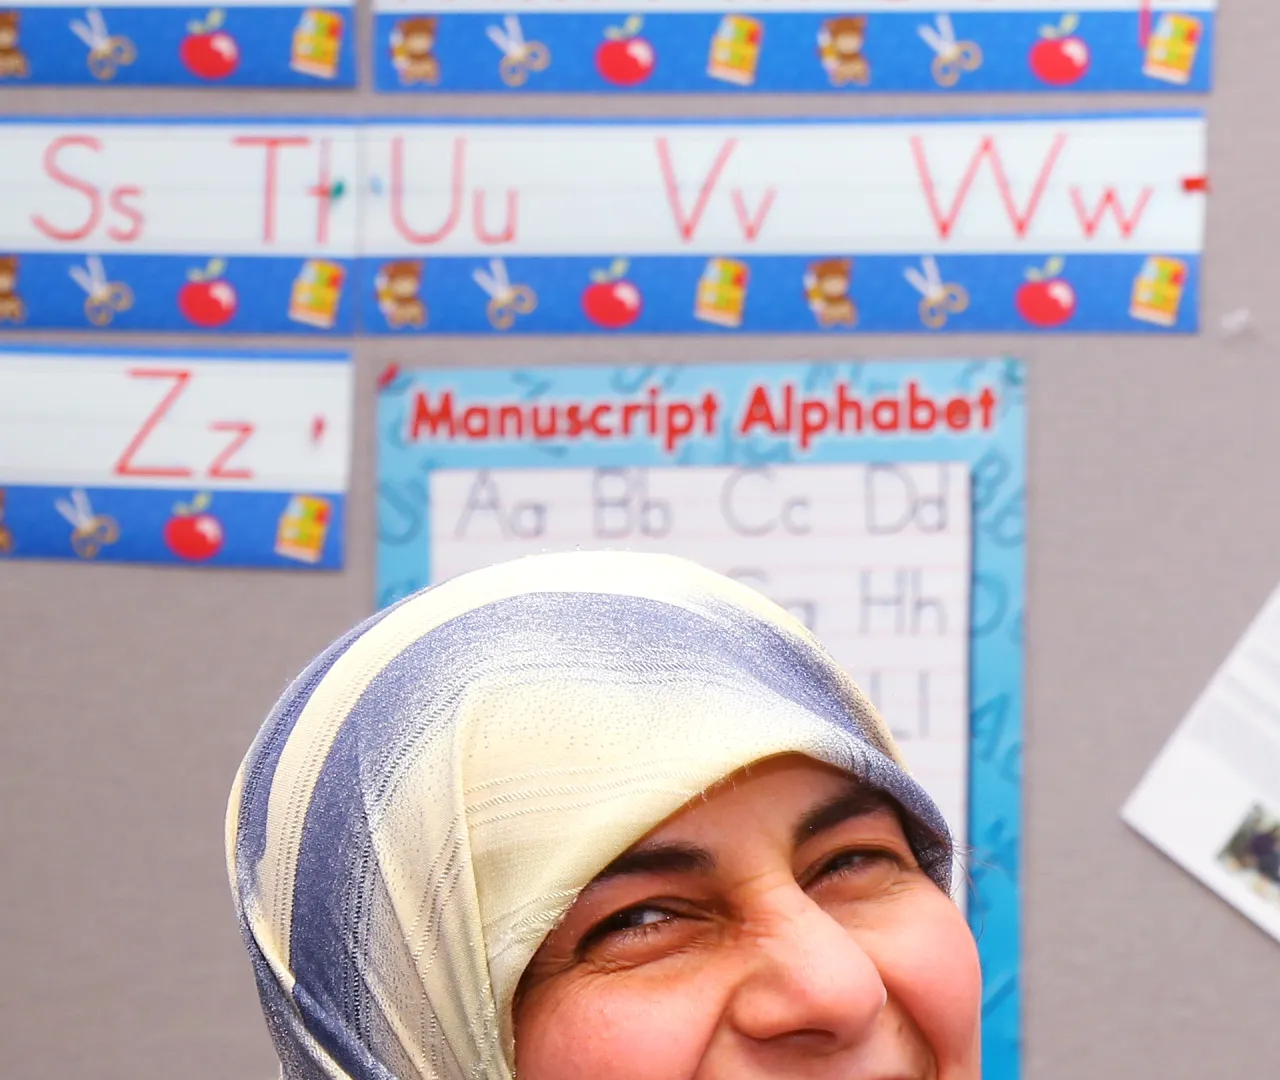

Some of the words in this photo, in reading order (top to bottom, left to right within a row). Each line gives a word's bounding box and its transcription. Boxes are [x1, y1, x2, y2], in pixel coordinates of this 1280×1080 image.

[30, 134, 147, 243] Ss
[388, 137, 518, 244] Uu
[654, 137, 778, 241] Vv
[910, 132, 1154, 239] Ww
[113, 368, 256, 479] Zz
[410, 389, 717, 451] Manuscript
[738, 382, 996, 449] Alphabet
[454, 470, 547, 540] Aa
[591, 468, 672, 537] Bb
[720, 466, 811, 537] Cc
[863, 462, 949, 535] Dd
[859, 569, 949, 636] Hh
